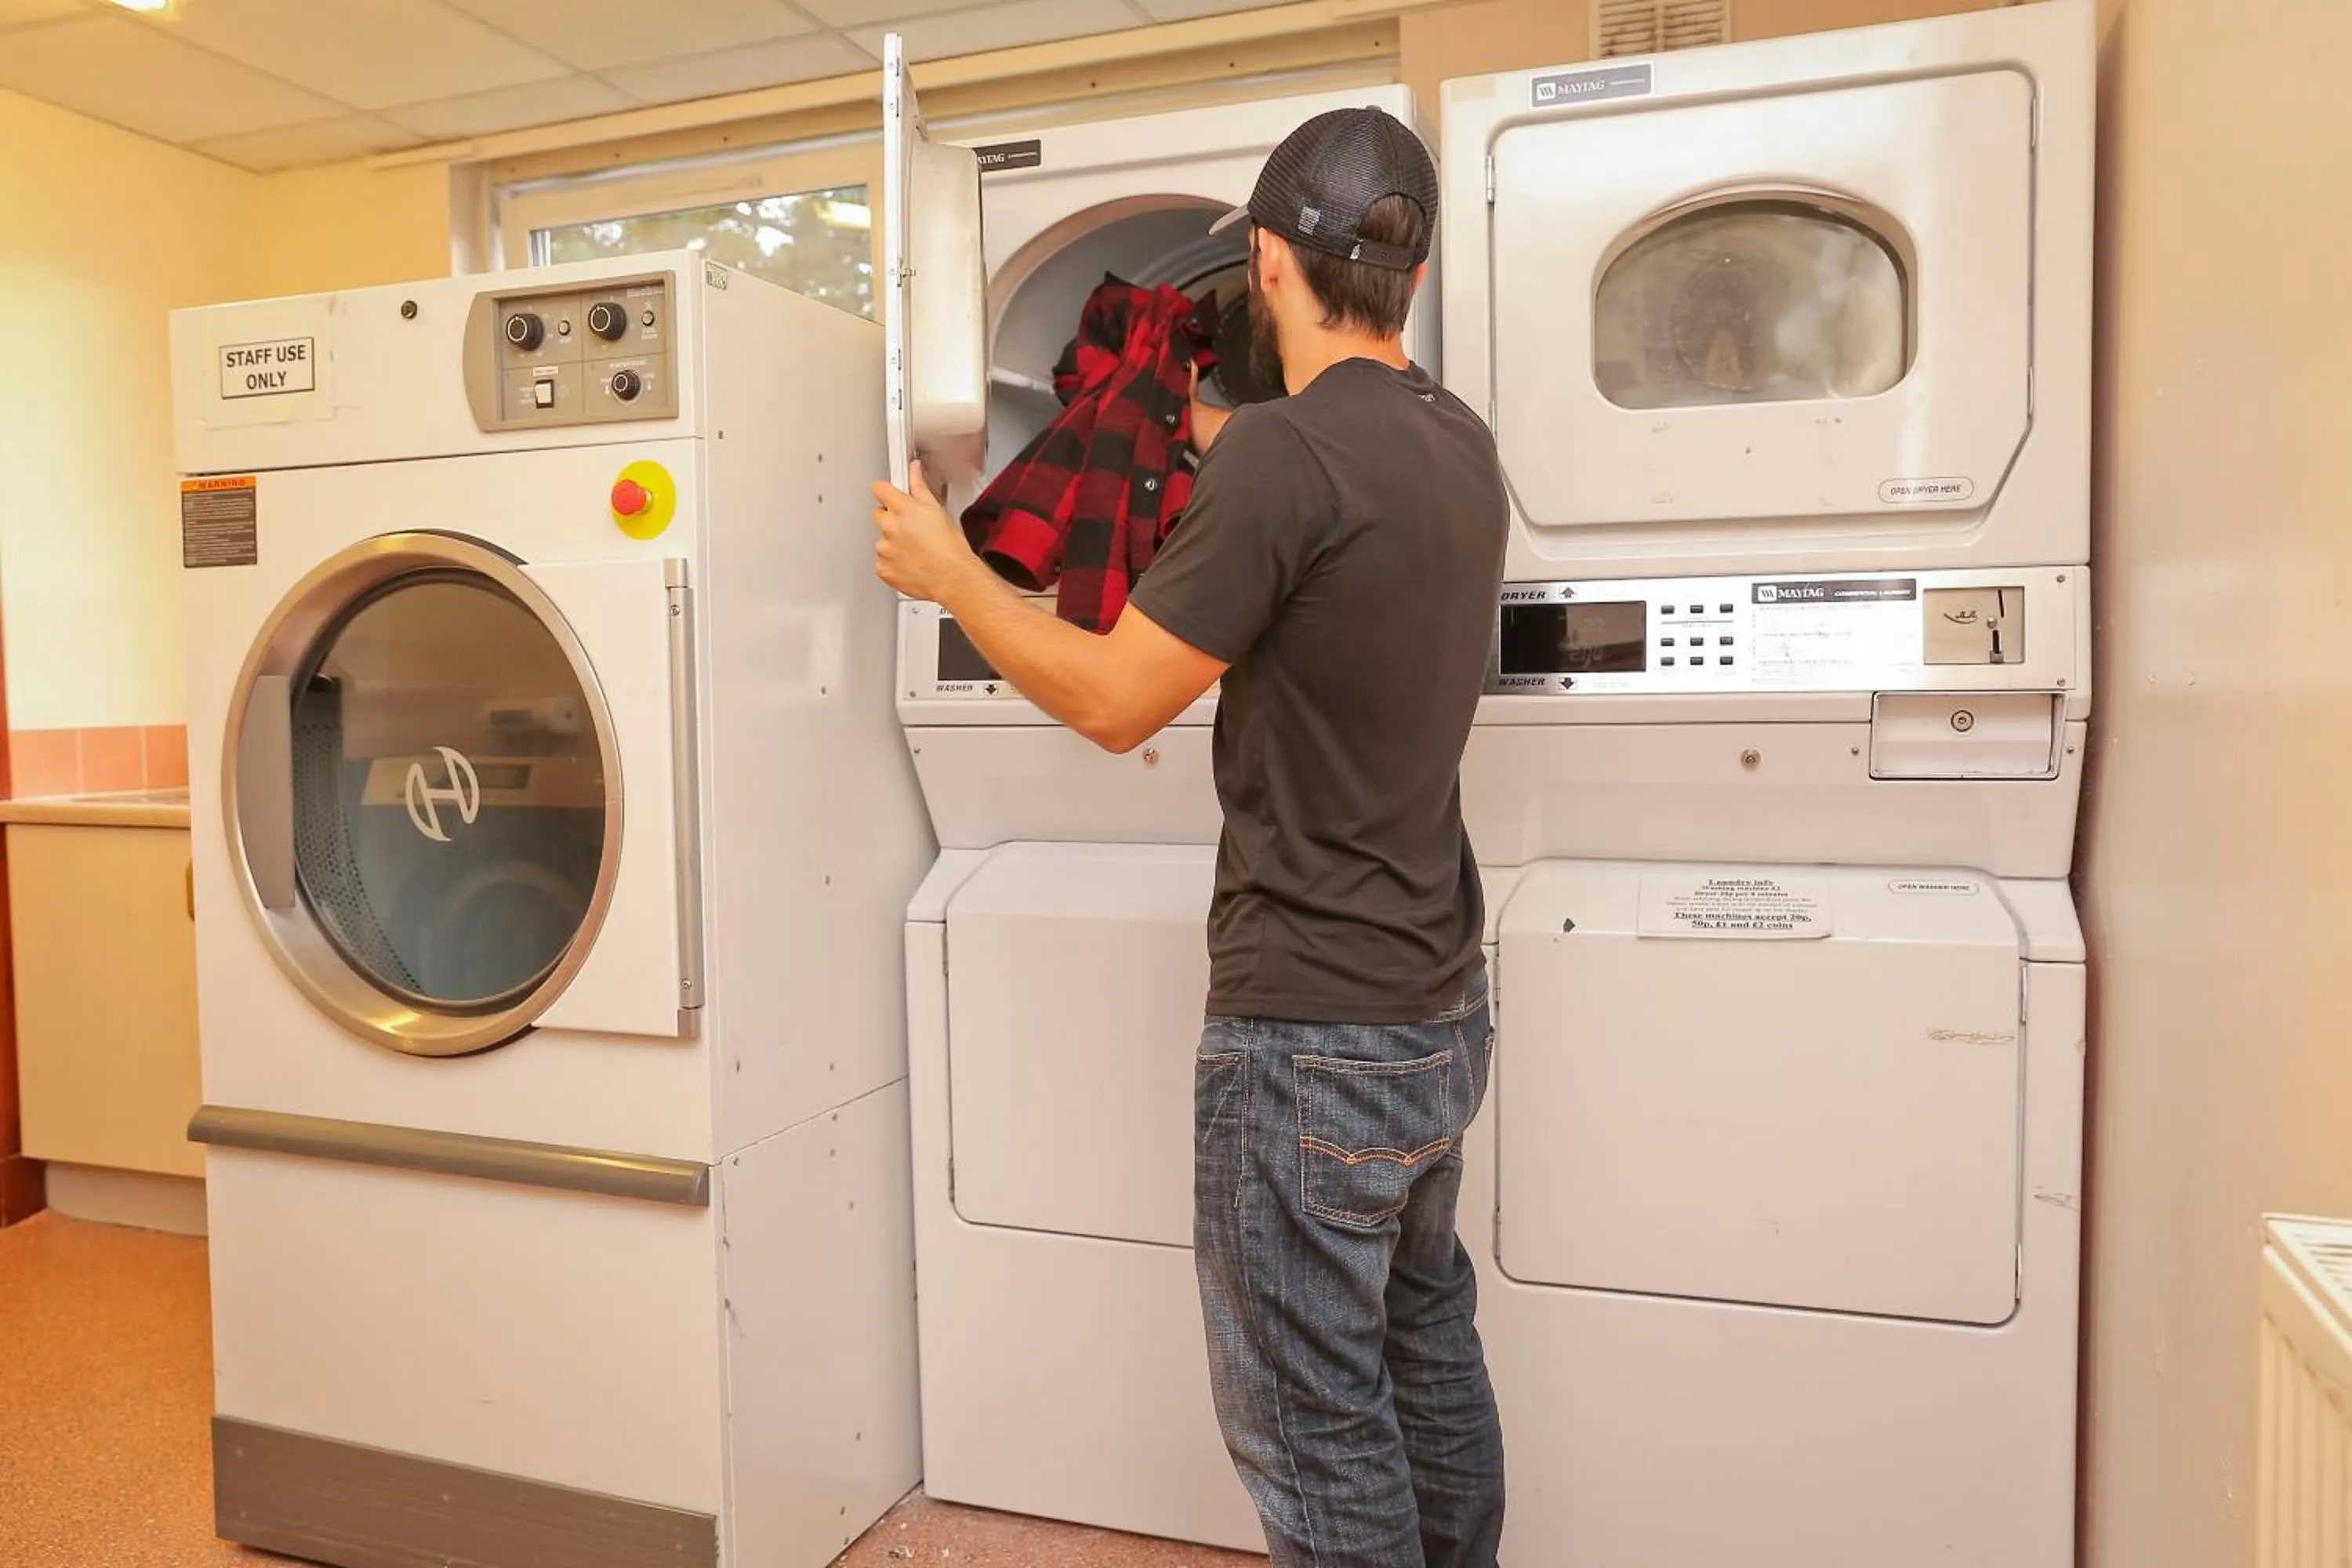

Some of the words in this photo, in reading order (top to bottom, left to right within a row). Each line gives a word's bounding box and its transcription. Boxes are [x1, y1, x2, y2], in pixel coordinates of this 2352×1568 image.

[1557, 79, 1605, 95] MAYTAG
[226, 347, 272, 368] STAFF
[276, 344, 306, 363] USE
[245, 371, 286, 390] ONLY
[199, 479, 245, 488] WARNING
[1890, 486, 1911, 496] OPEN
[1940, 484, 1962, 493] HERE
[1501, 590, 1546, 601] DRYER
[1777, 587, 1824, 599] MAYTAG
[936, 684, 973, 692] WASHER
[1498, 677, 1545, 687] WASHER
